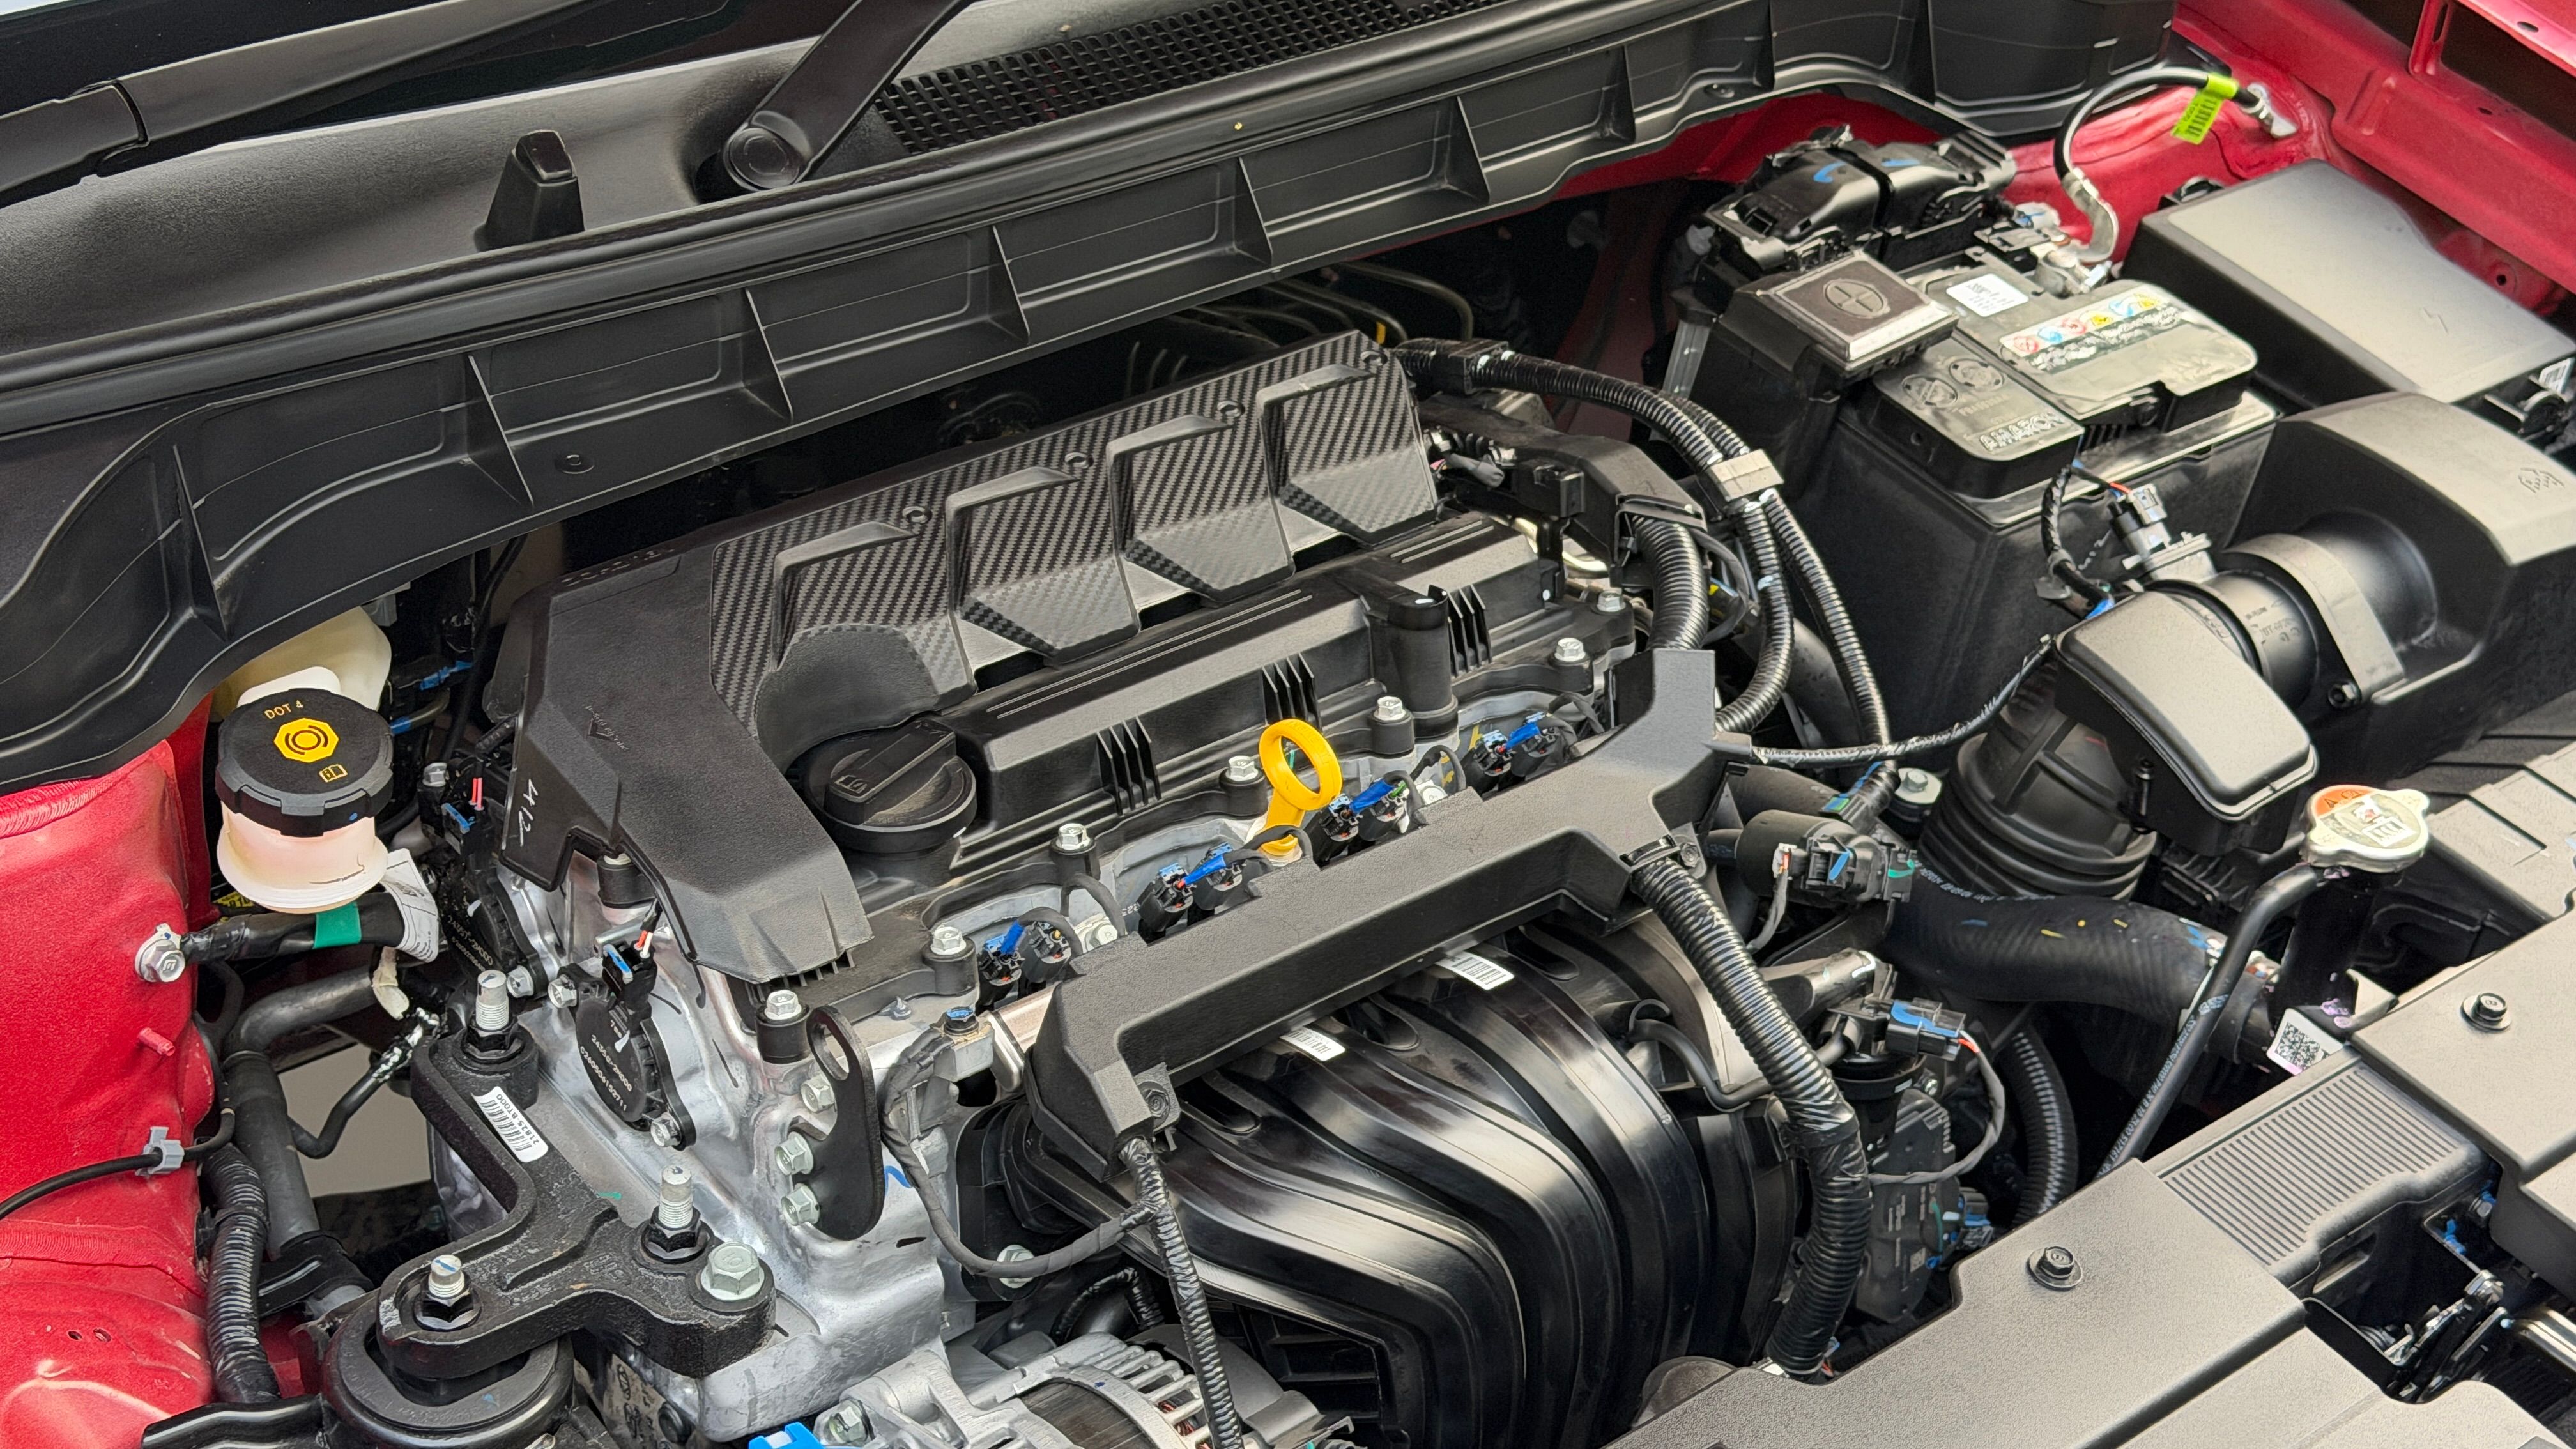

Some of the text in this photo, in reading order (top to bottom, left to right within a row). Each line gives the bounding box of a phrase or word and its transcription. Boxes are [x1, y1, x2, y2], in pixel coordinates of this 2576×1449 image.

[264, 700, 304, 719] DOT 4
[518, 779, 539, 847] 412
[496, 1093, 540, 1146] 21825-BT000
